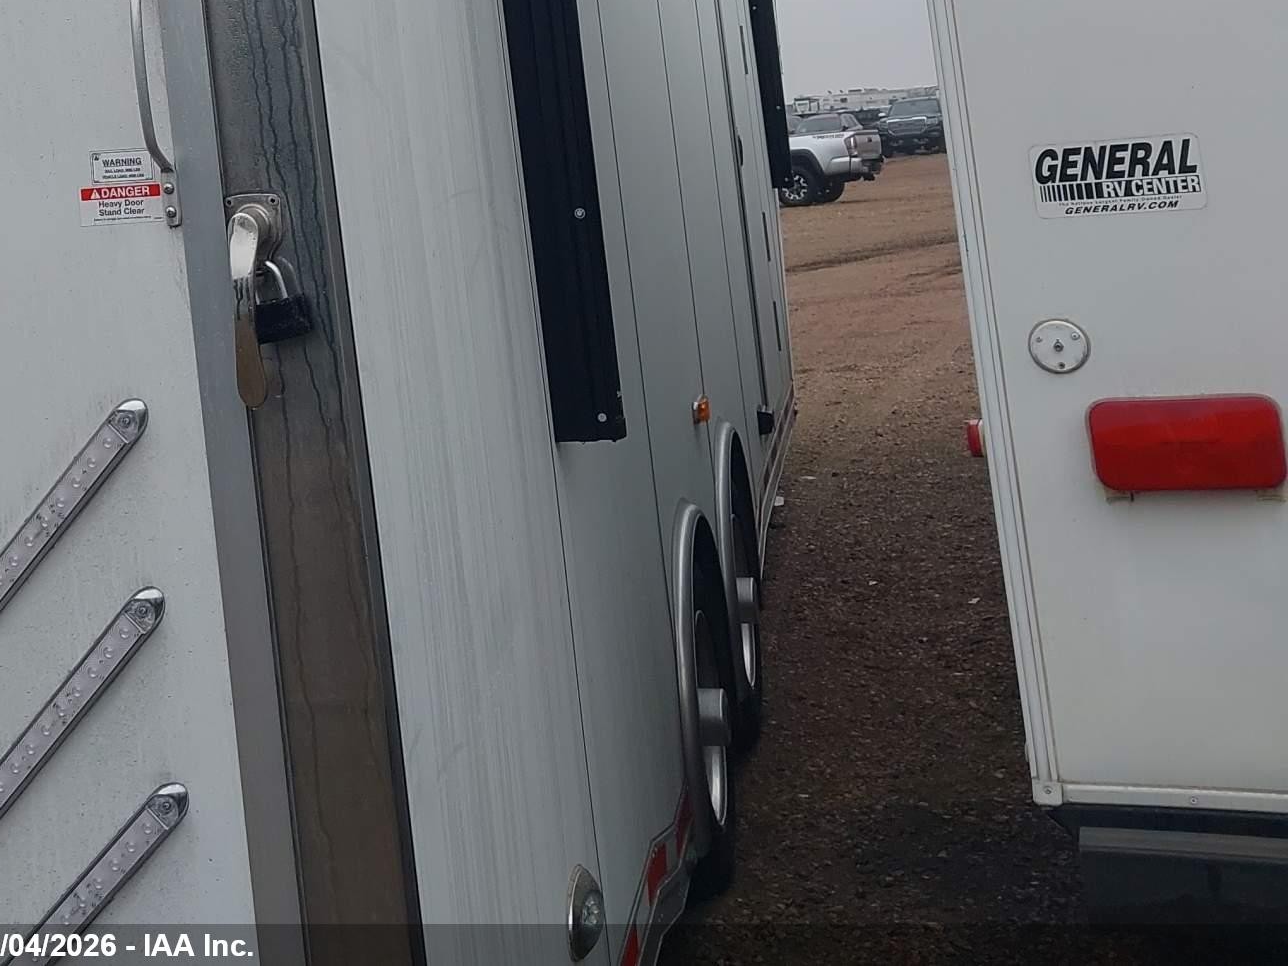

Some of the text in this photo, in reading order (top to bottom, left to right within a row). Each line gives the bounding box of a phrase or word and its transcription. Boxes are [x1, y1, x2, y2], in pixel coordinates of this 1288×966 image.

[102, 157, 142, 167] WARNING
[1035, 138, 1198, 185] GENERAL
[101, 186, 150, 198] DANGER
[1102, 175, 1201, 198] RV CENTER
[98, 199, 144, 209] Heavy Door
[1065, 200, 1179, 215] GENERALRV.COM
[98, 207, 145, 217] Stand Clear
